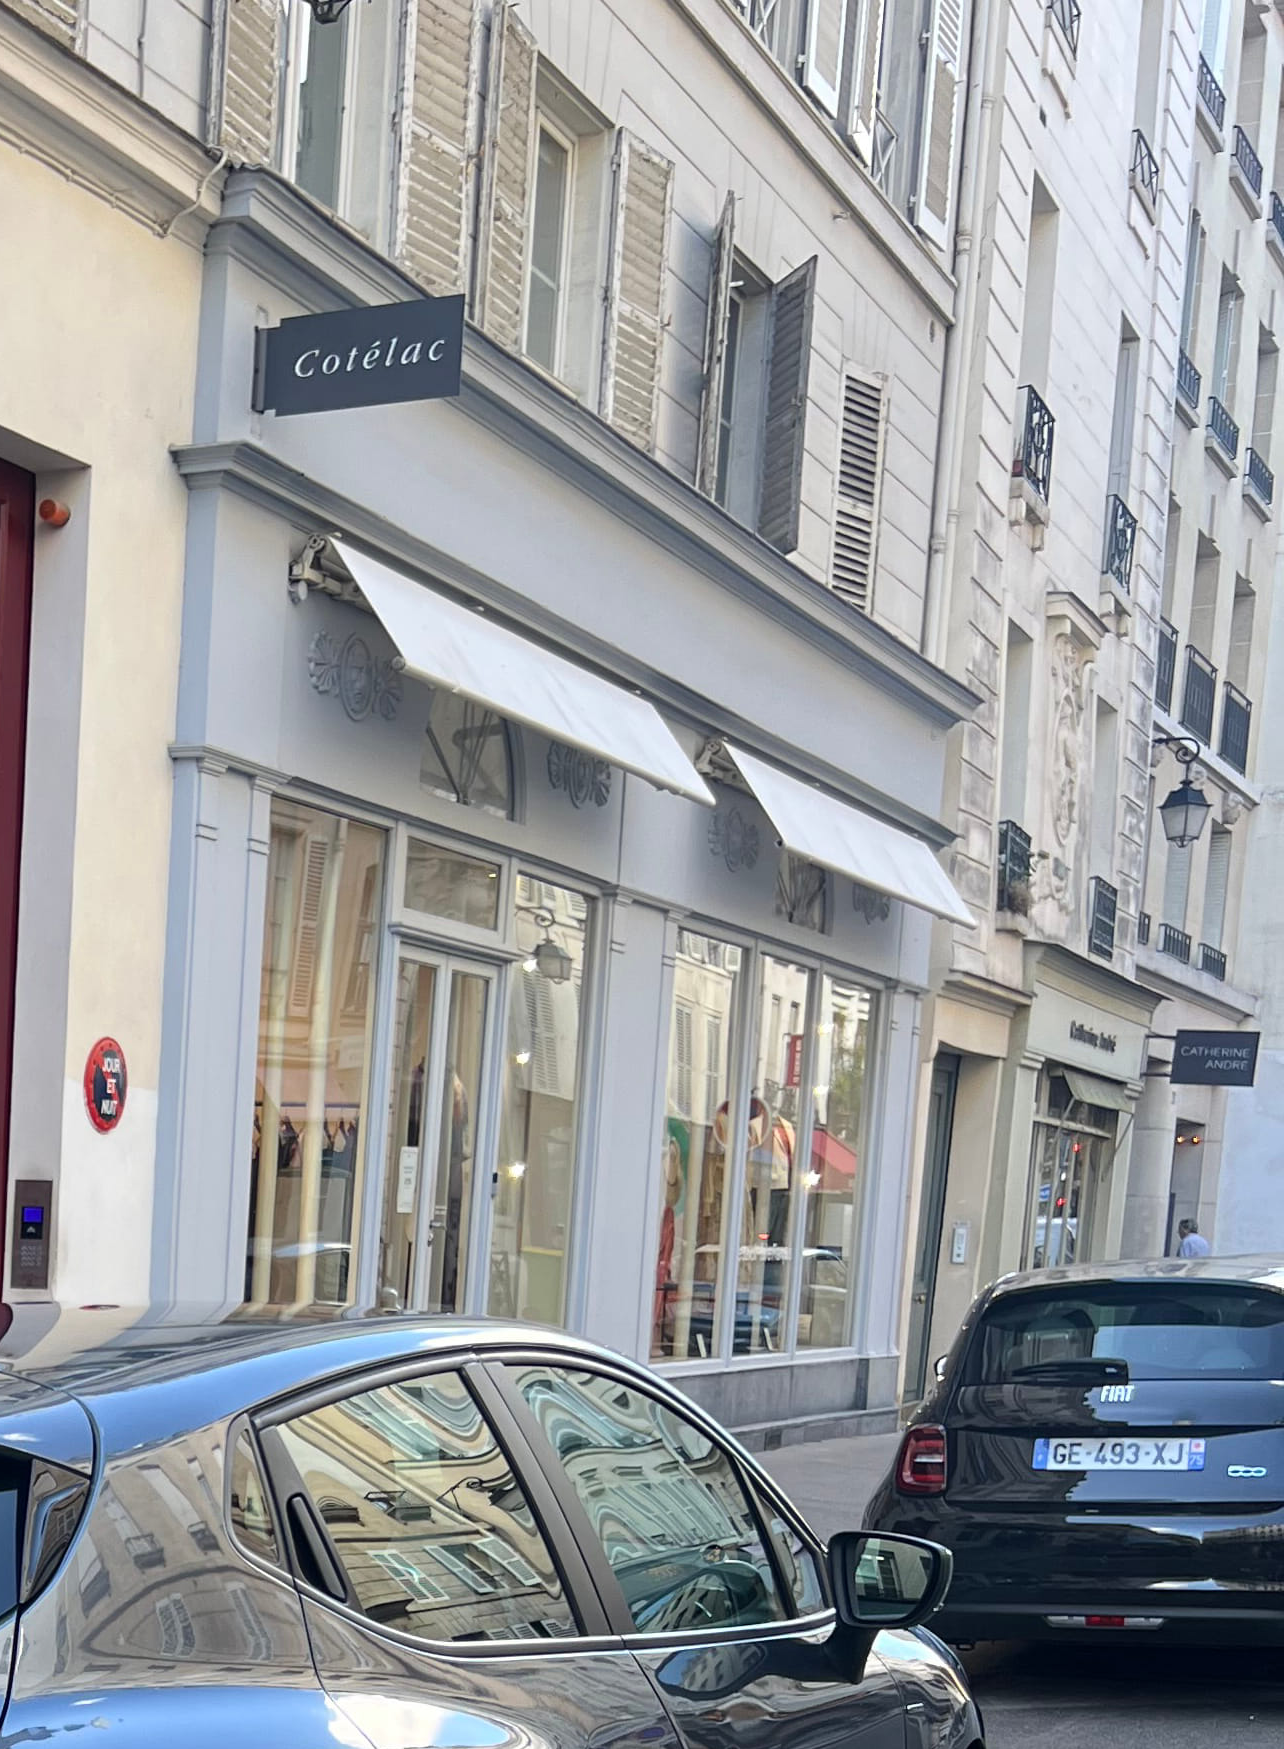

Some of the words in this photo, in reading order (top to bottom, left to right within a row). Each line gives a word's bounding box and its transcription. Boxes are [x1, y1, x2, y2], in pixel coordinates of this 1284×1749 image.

[293, 336, 445, 378] Cotélac
[1180, 1046, 1251, 1059] CATHERINE
[102, 1057, 121, 1073] JOUR
[106, 1079, 116, 1094] ET
[100, 1099, 117, 1115] NUIT
[1100, 1385, 1135, 1402] FIAT
[1053, 1442, 1184, 1466] GE-493-XJ
[1188, 1455, 1204, 1466] 75
